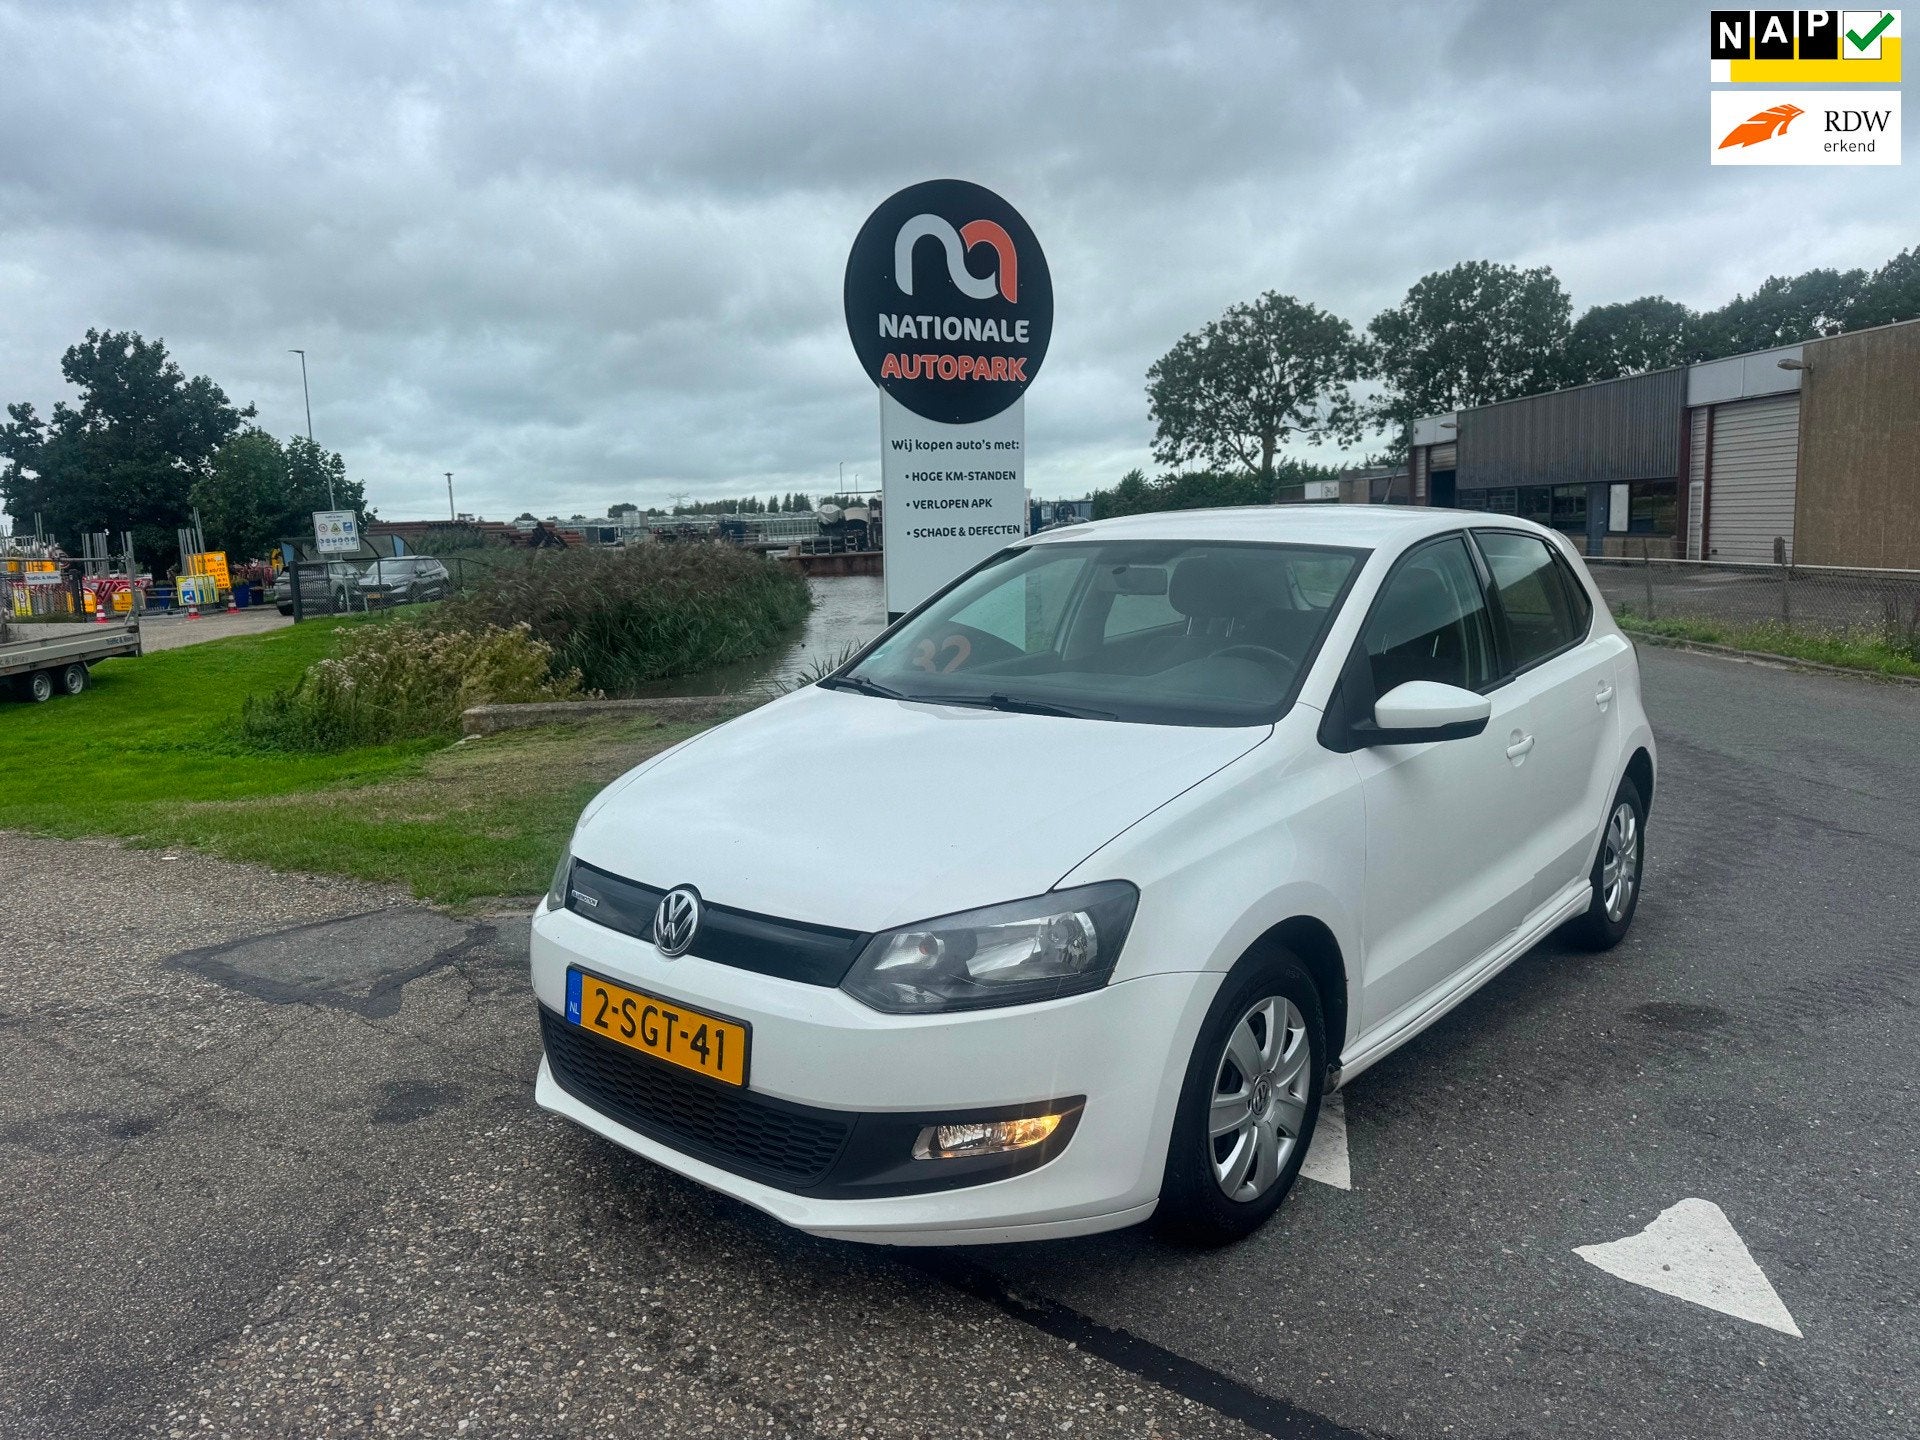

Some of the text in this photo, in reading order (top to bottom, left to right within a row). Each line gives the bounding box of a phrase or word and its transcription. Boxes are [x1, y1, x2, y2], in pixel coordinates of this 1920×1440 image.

[878, 313, 1030, 344] NATIONALE
[881, 352, 1028, 382] AUTOPARK
[891, 439, 1019, 453] Wij kopen auto's met:
[912, 470, 1016, 482] HOGE KM-STANDEN
[912, 498, 993, 510] VERLOPEN APK
[913, 525, 1021, 538] SCHADE & DEFECTEN
[911, 634, 971, 674] 32
[569, 1001, 580, 1015] NL
[593, 987, 726, 1072] 2-SGT-41
